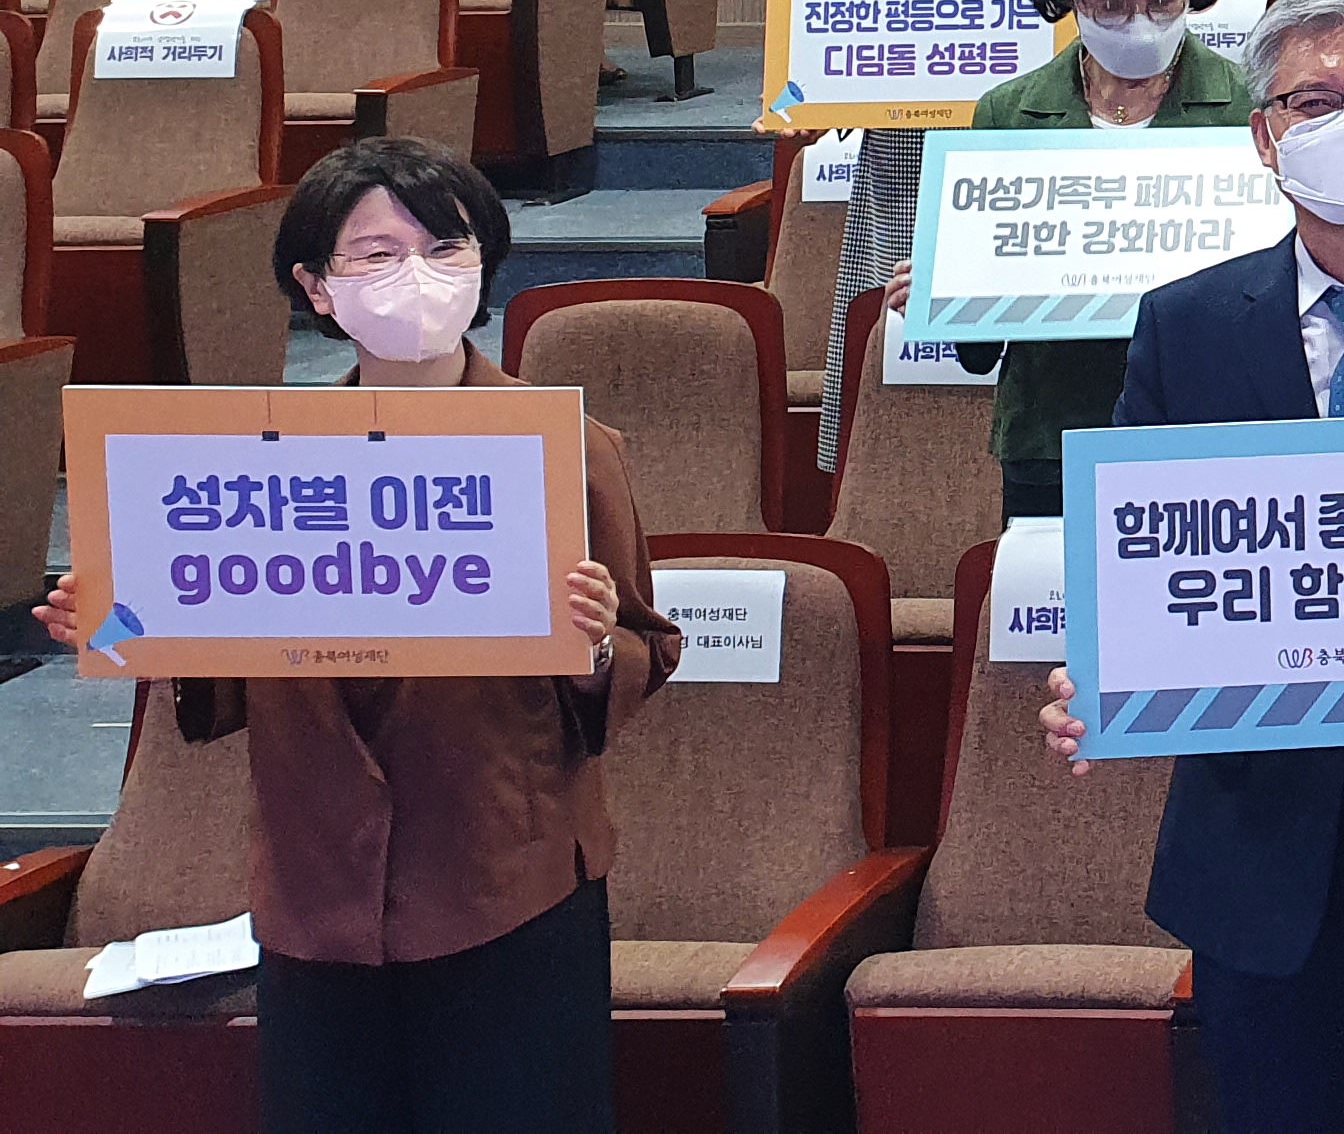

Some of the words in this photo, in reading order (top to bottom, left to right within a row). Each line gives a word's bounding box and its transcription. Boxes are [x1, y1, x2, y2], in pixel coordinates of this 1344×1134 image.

[805, 0, 881, 34] 진정한
[885, 0, 985, 32] 평등으로
[107, 45, 154, 62] 사회적
[162, 45, 223, 62] 거리두기
[824, 43, 917, 77] 디딤돌
[926, 42, 1019, 75] 성평등
[952, 177, 1128, 212] 여성가족부
[1135, 175, 1205, 208] 폐지
[1212, 172, 1281, 207] 반대
[993, 221, 1071, 257] 권한
[1081, 218, 1235, 255] 강화하라
[162, 474, 349, 532] 성차별
[369, 474, 494, 532] 이젠
[1113, 494, 1305, 560] 함께여서
[170, 541, 492, 606] goodbye
[668, 608, 747, 621] 충북여성재단
[1167, 566, 1272, 627] 우리
[697, 635, 763, 649] 대표이사님
